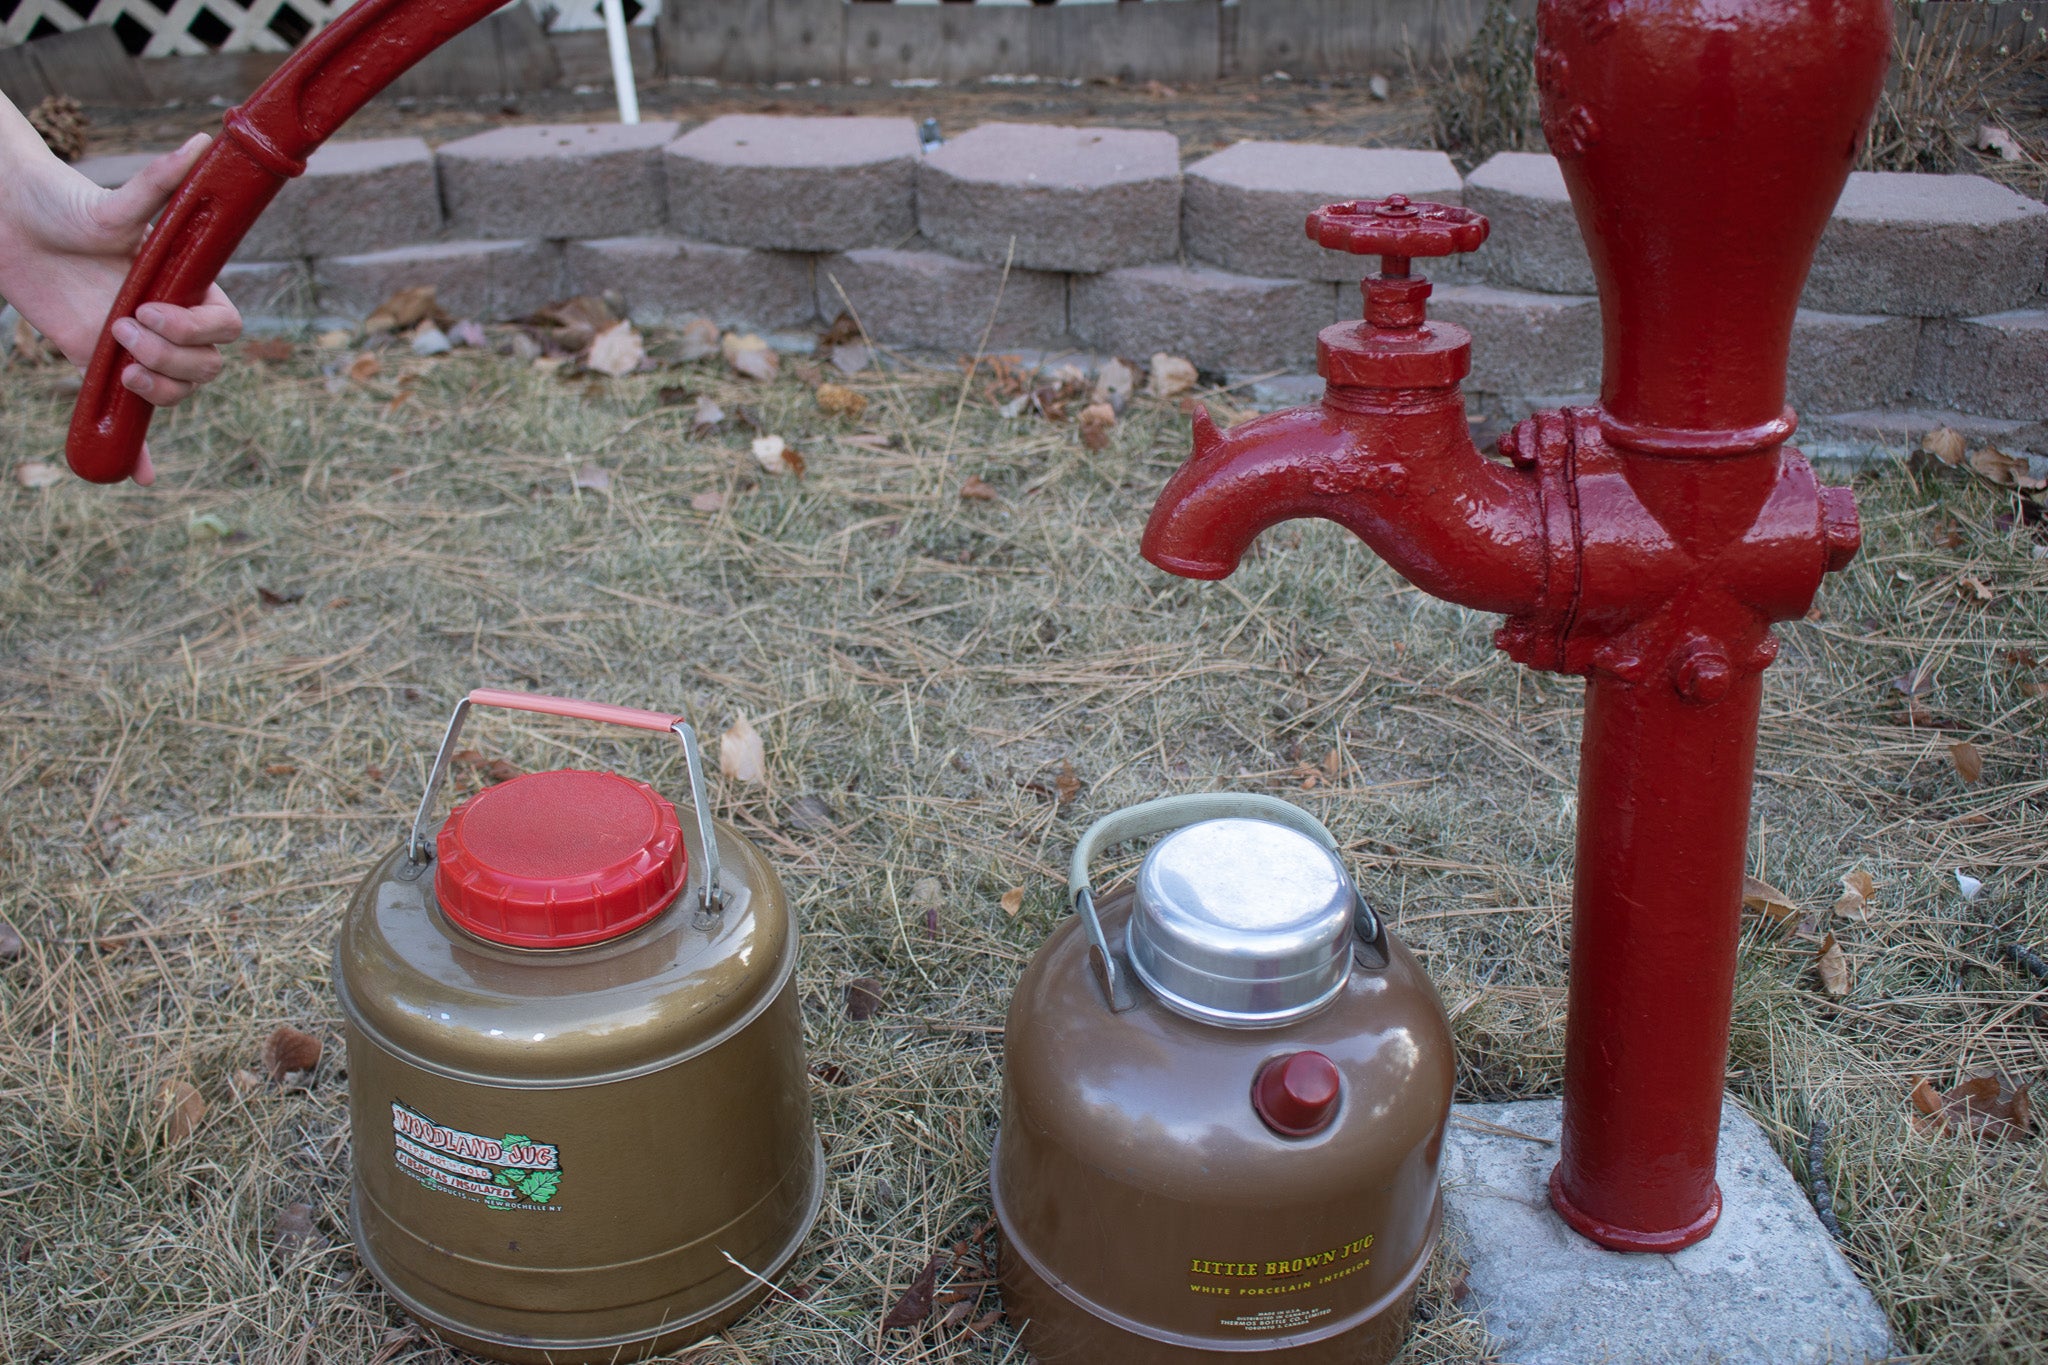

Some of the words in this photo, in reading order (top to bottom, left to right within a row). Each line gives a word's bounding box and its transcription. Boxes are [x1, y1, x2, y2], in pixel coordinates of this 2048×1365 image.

[396, 1110, 502, 1160] WOODLAND
[508, 1144, 552, 1165] JUG
[399, 1153, 448, 1183] FIBERGLAS
[451, 1177, 511, 1197] INSULATED
[430, 1154, 446, 1166] HOT
[461, 1165, 488, 1177] COLD
[427, 1181, 467, 1199] PRODUCTS
[505, 1202, 547, 1211] ROCHELLE
[1191, 1259, 1258, 1276] LITTLE
[1264, 1250, 1337, 1275] BROWN
[1341, 1234, 1374, 1259] JUG
[1190, 1284, 1231, 1295] WHITE
[1240, 1281, 1311, 1295] PORCELAIN
[1319, 1259, 1371, 1284] INTERIOR
[1304, 1308, 1332, 1320] LIMITED
